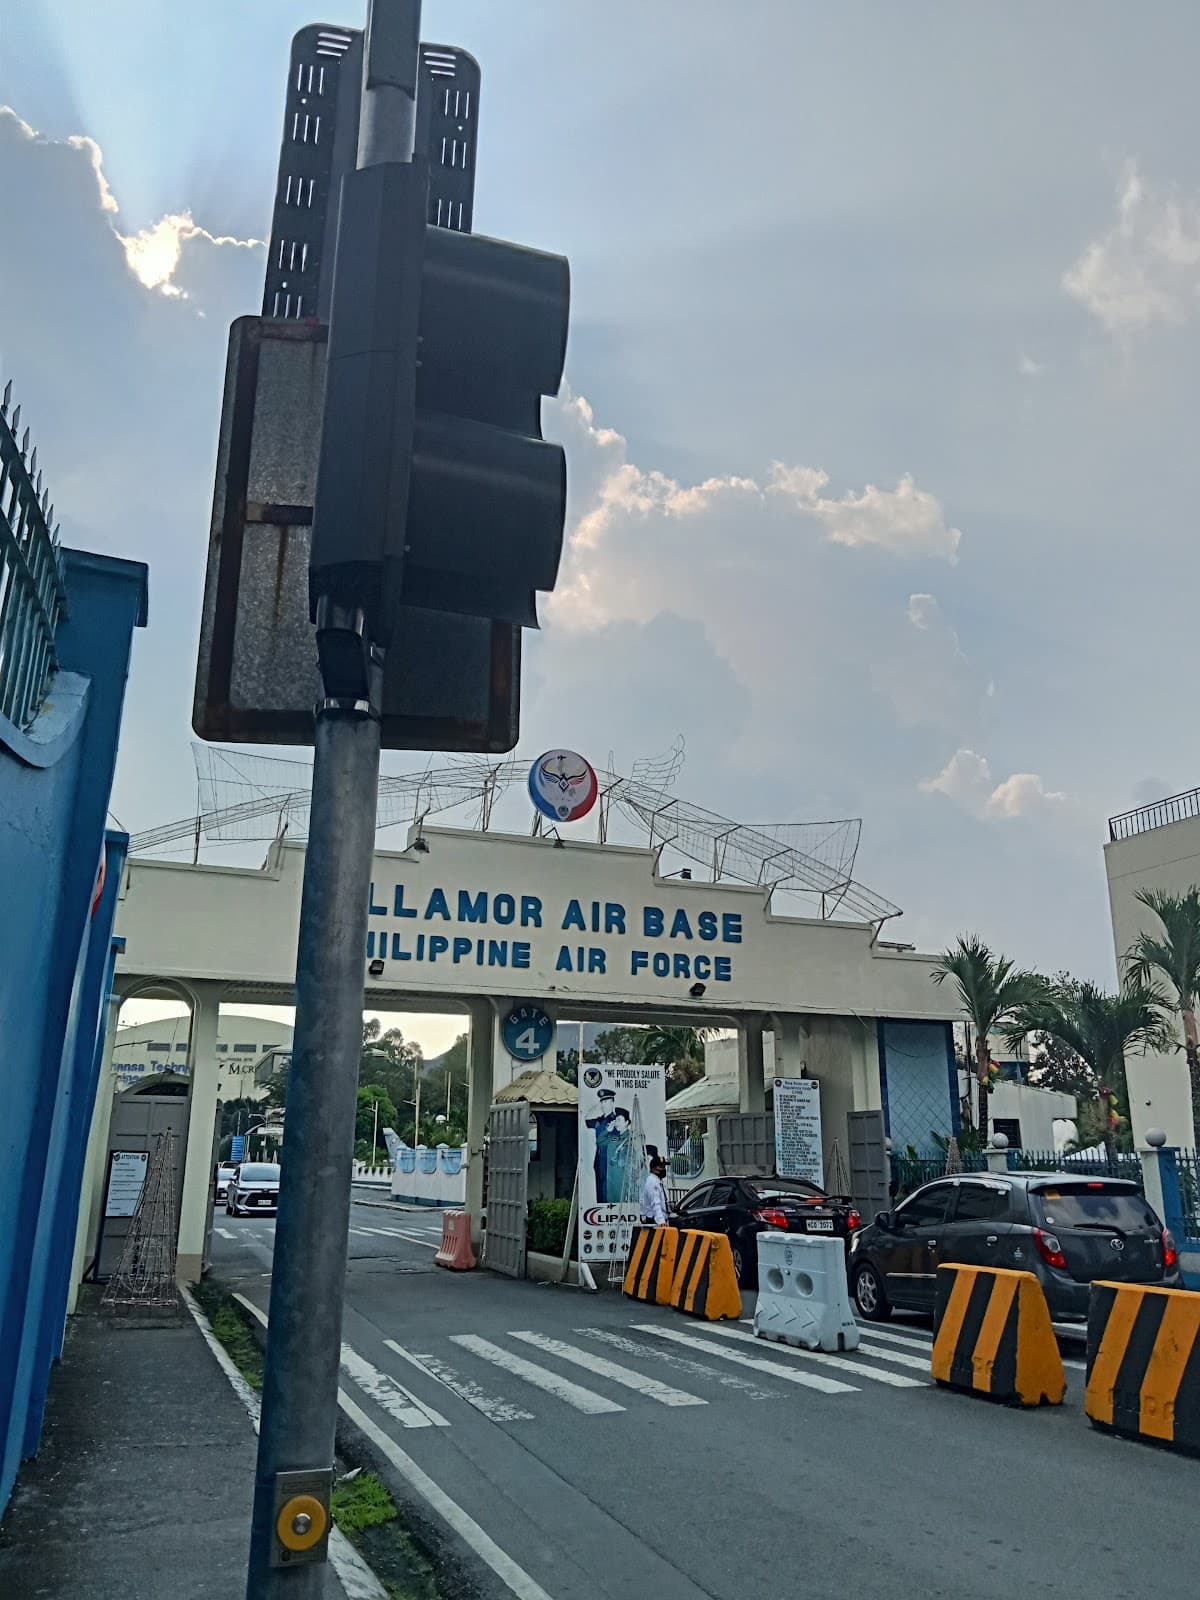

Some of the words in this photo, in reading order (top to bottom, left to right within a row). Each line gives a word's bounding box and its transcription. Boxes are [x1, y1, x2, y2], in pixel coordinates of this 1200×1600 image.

[561, 899, 626, 934] AIR
[643, 906, 743, 943] BASE
[555, 946, 607, 974] AIR
[630, 951, 732, 981] FORCE
[508, 1007, 549, 1027] GATE
[515, 1027, 541, 1055] 4
[605, 1069, 616, 1079] "WE
[616, 1069, 640, 1079] PROUDLY
[641, 1070, 660, 1079] SALUTE
[615, 1080, 621, 1089] IN
[622, 1080, 634, 1089] THIS
[634, 1080, 651, 1089] BASE"
